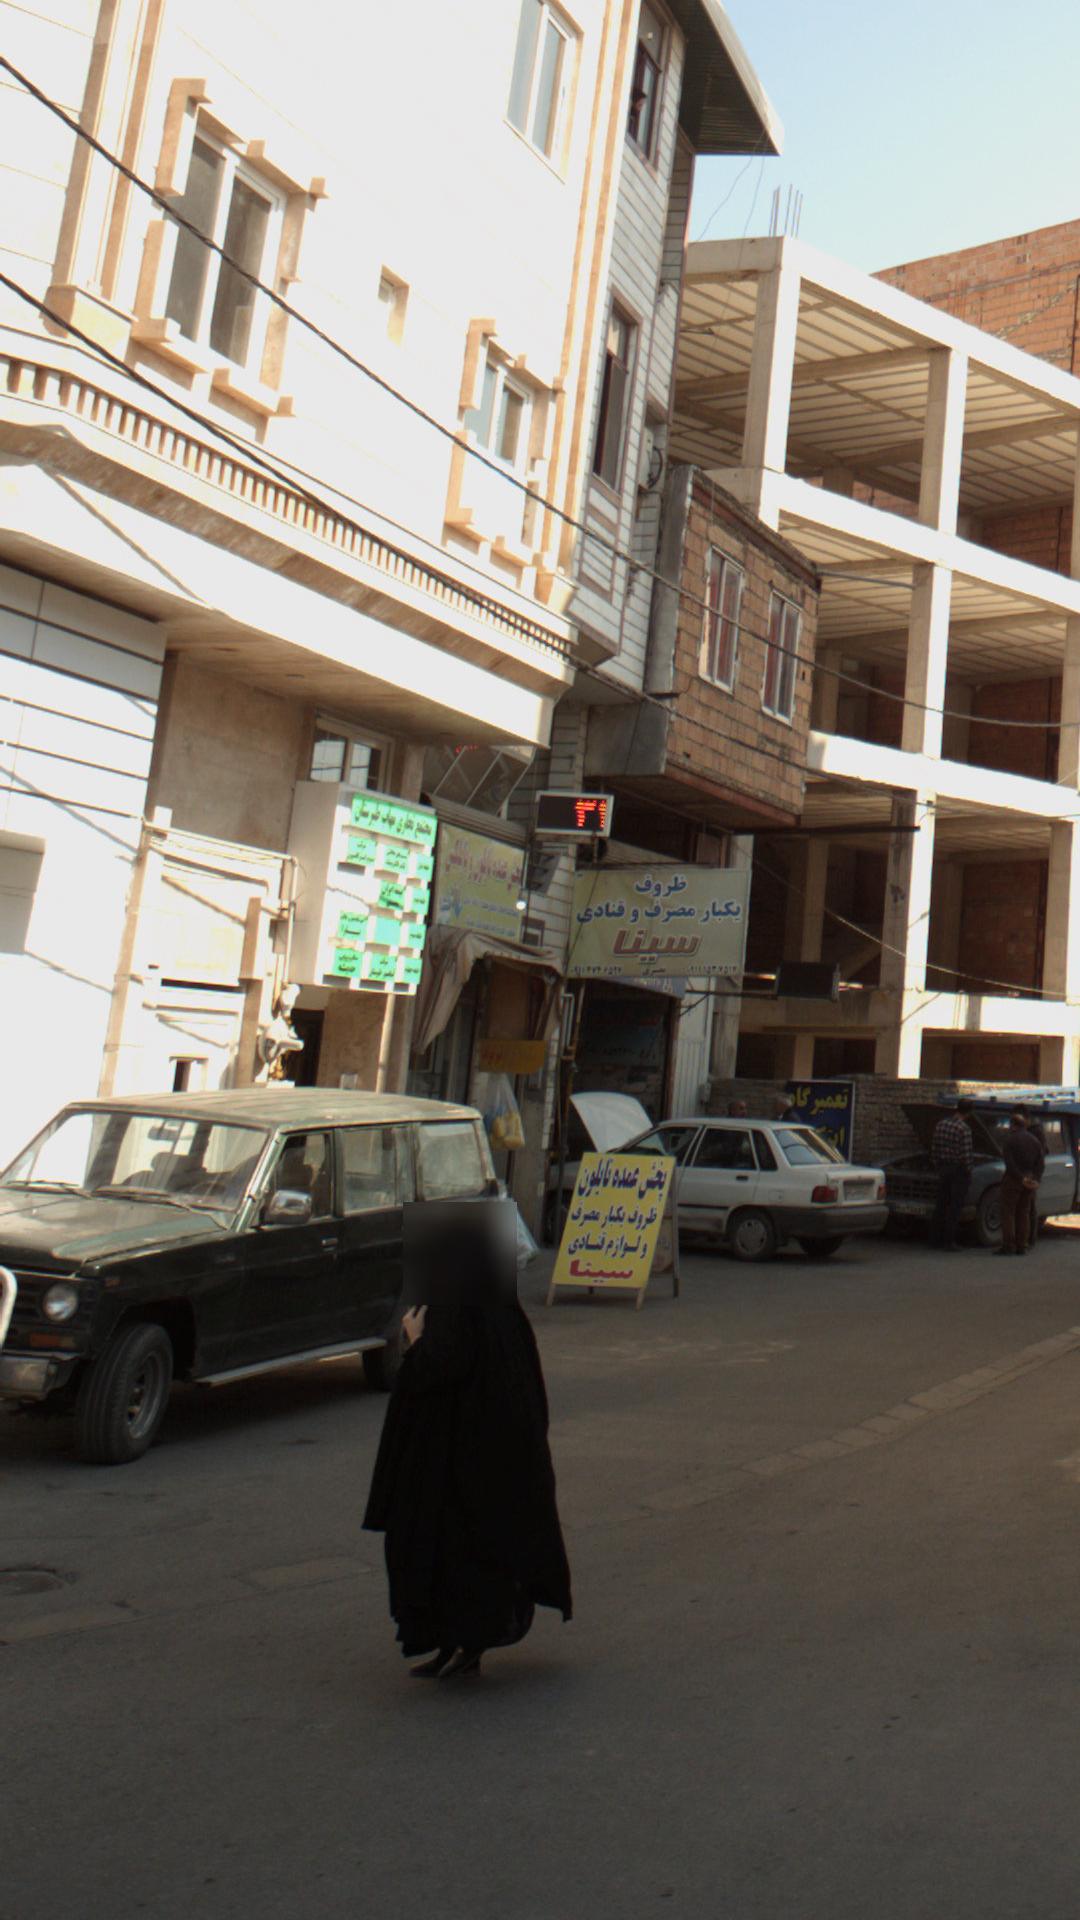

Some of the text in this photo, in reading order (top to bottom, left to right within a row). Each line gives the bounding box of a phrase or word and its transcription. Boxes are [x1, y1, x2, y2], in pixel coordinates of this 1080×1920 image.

[635, 875, 687, 897] ظروف
[575, 900, 742, 924] یکبار مصرف و قنادی
[611, 1164, 640, 1190] عمده
[639, 1161, 667, 1200] پخش
[570, 1201, 658, 1231] ظروف یکبار مصرف
[567, 1229, 606, 1256] قنادی
[639, 1243, 649, 1259] و
